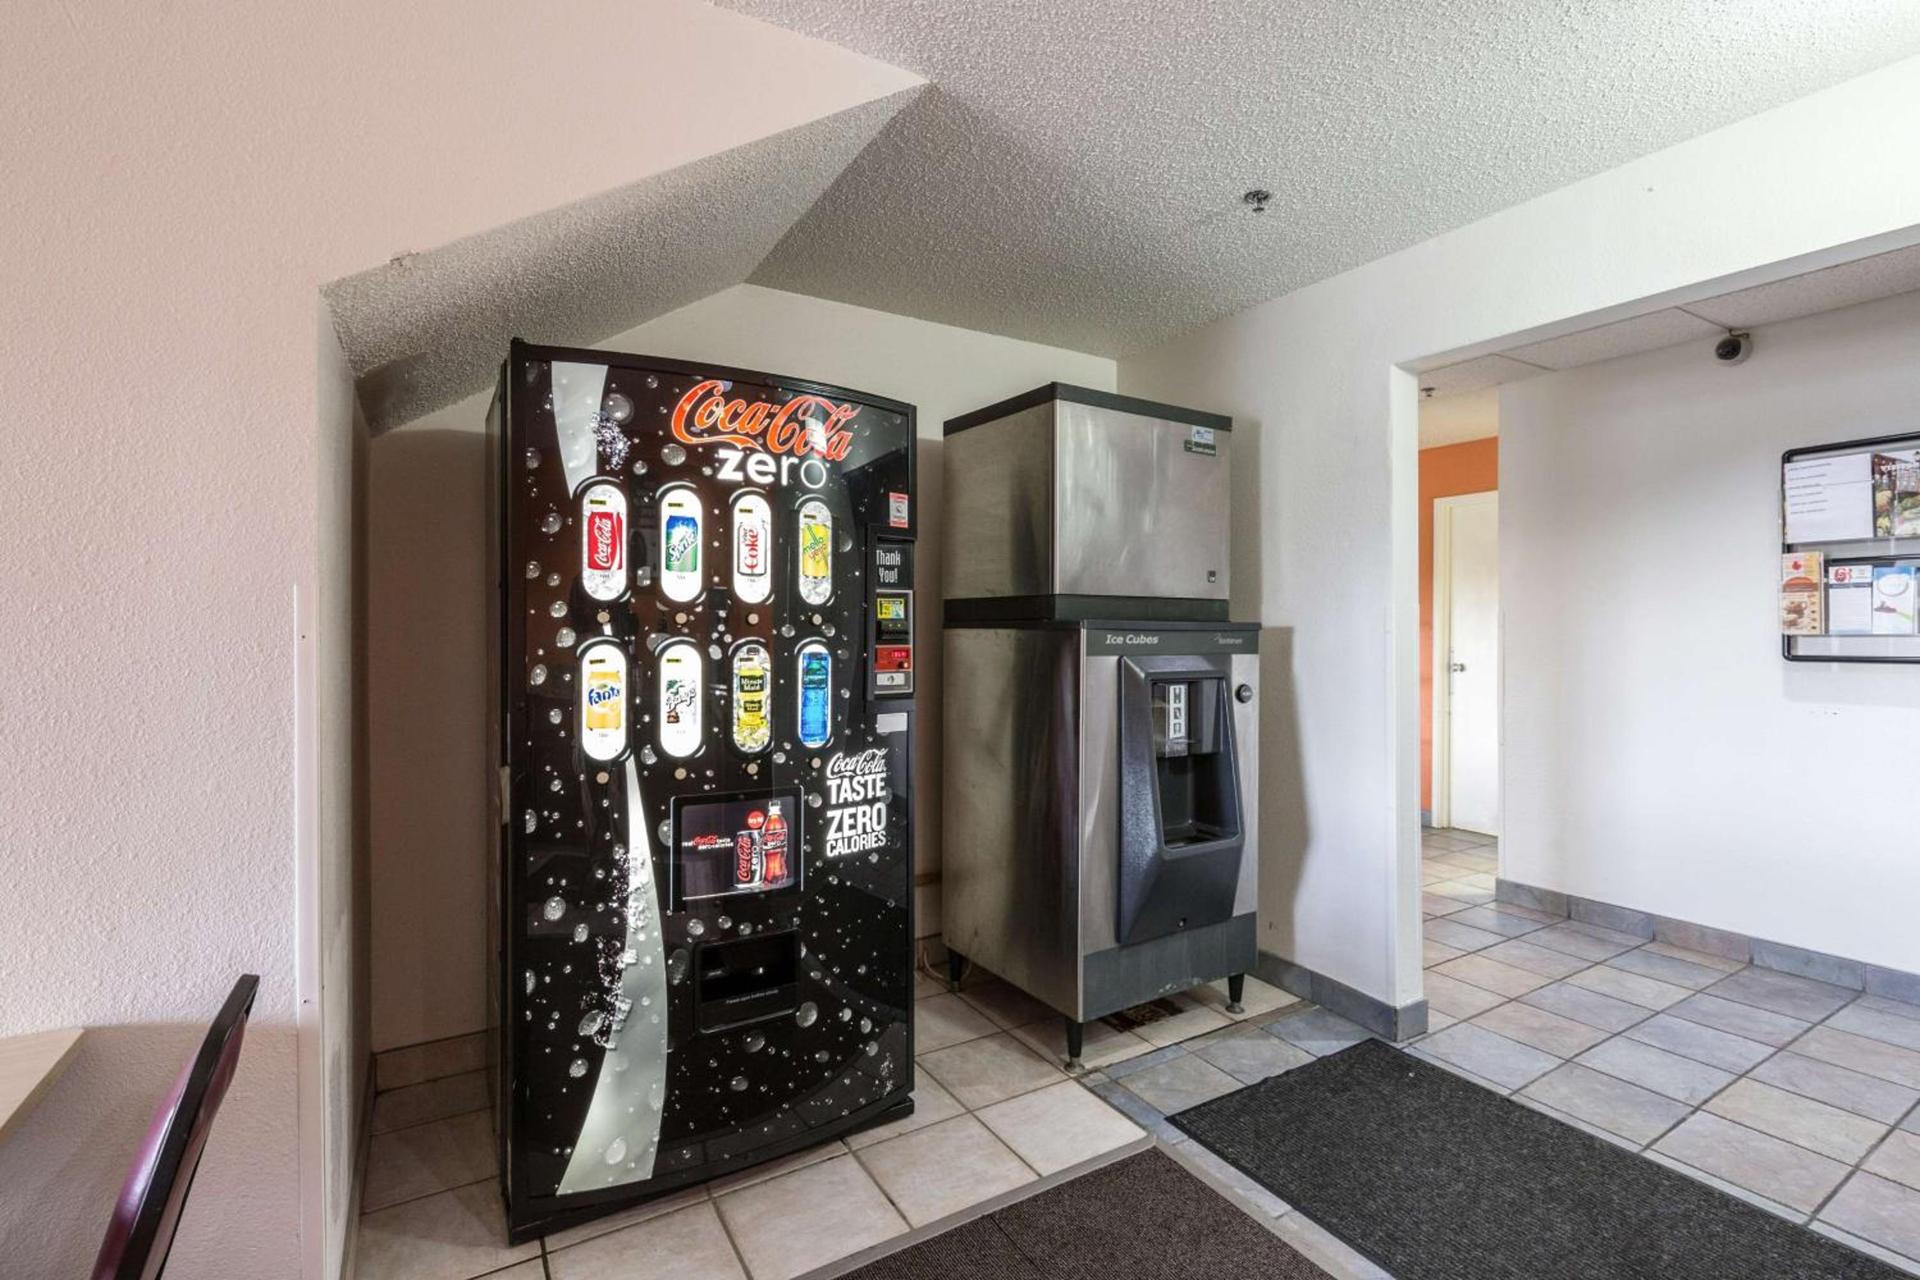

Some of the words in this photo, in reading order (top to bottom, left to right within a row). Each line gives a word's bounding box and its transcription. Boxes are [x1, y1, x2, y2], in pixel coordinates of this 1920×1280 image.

[672, 380, 863, 461] Coca-Cola
[716, 449, 827, 489] zero
[876, 550, 901, 566] Thank
[878, 567, 898, 583] You!
[1105, 634, 1123, 645] Ice
[1126, 634, 1160, 645] Cubes
[826, 748, 888, 779] Coca-Cola
[826, 773, 887, 805] TASTE
[826, 802, 887, 841] ZERO
[826, 831, 887, 857] CALORIES
